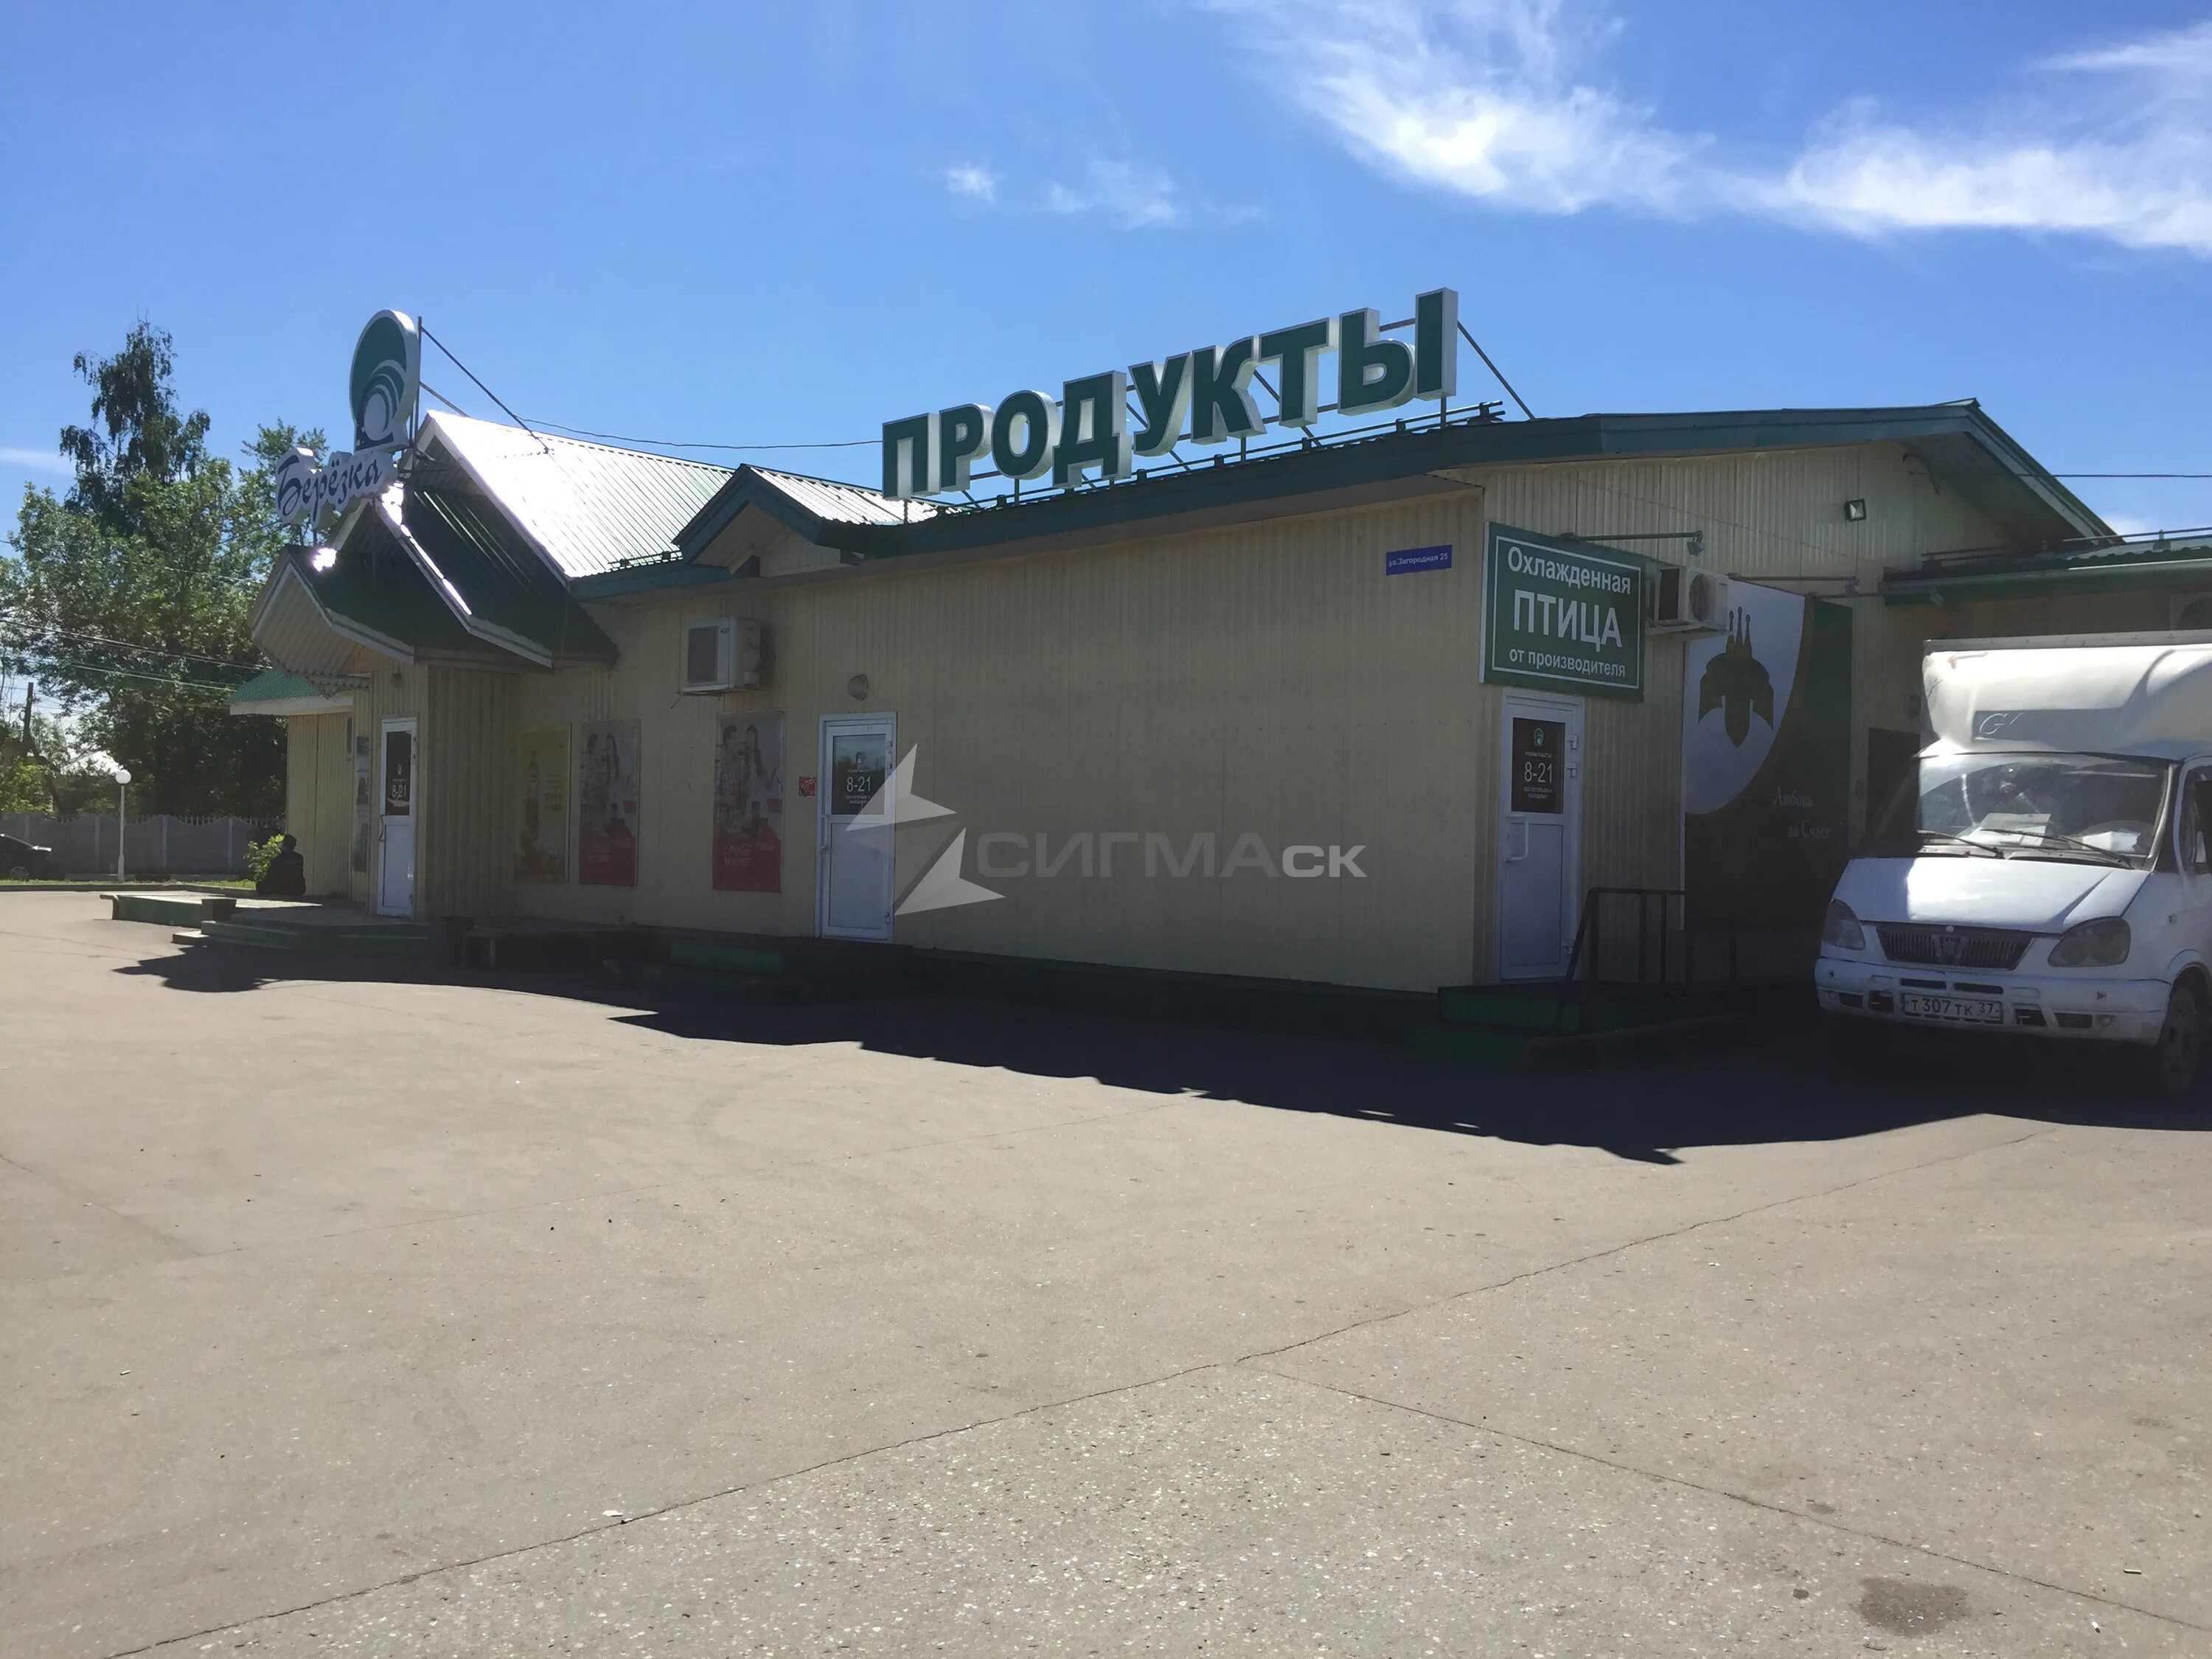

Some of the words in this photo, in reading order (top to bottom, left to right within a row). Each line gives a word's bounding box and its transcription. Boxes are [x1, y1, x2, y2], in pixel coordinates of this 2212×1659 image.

[882, 287, 1458, 501] ПРОДУКТЫ
[277, 454, 383, 522] Берёзка
[1439, 552, 1448, 560] 25
[1507, 546, 1631, 594] Охлажденная
[1514, 589, 1622, 652] ПТИЦА
[1509, 648, 1525, 663] от
[1528, 651, 1626, 677] производителя
[846, 776, 872, 792] 8-21
[1524, 761, 1552, 783] 8-21
[392, 784, 407, 798] 8-21
[1978, 1002, 1994, 1015] 37
